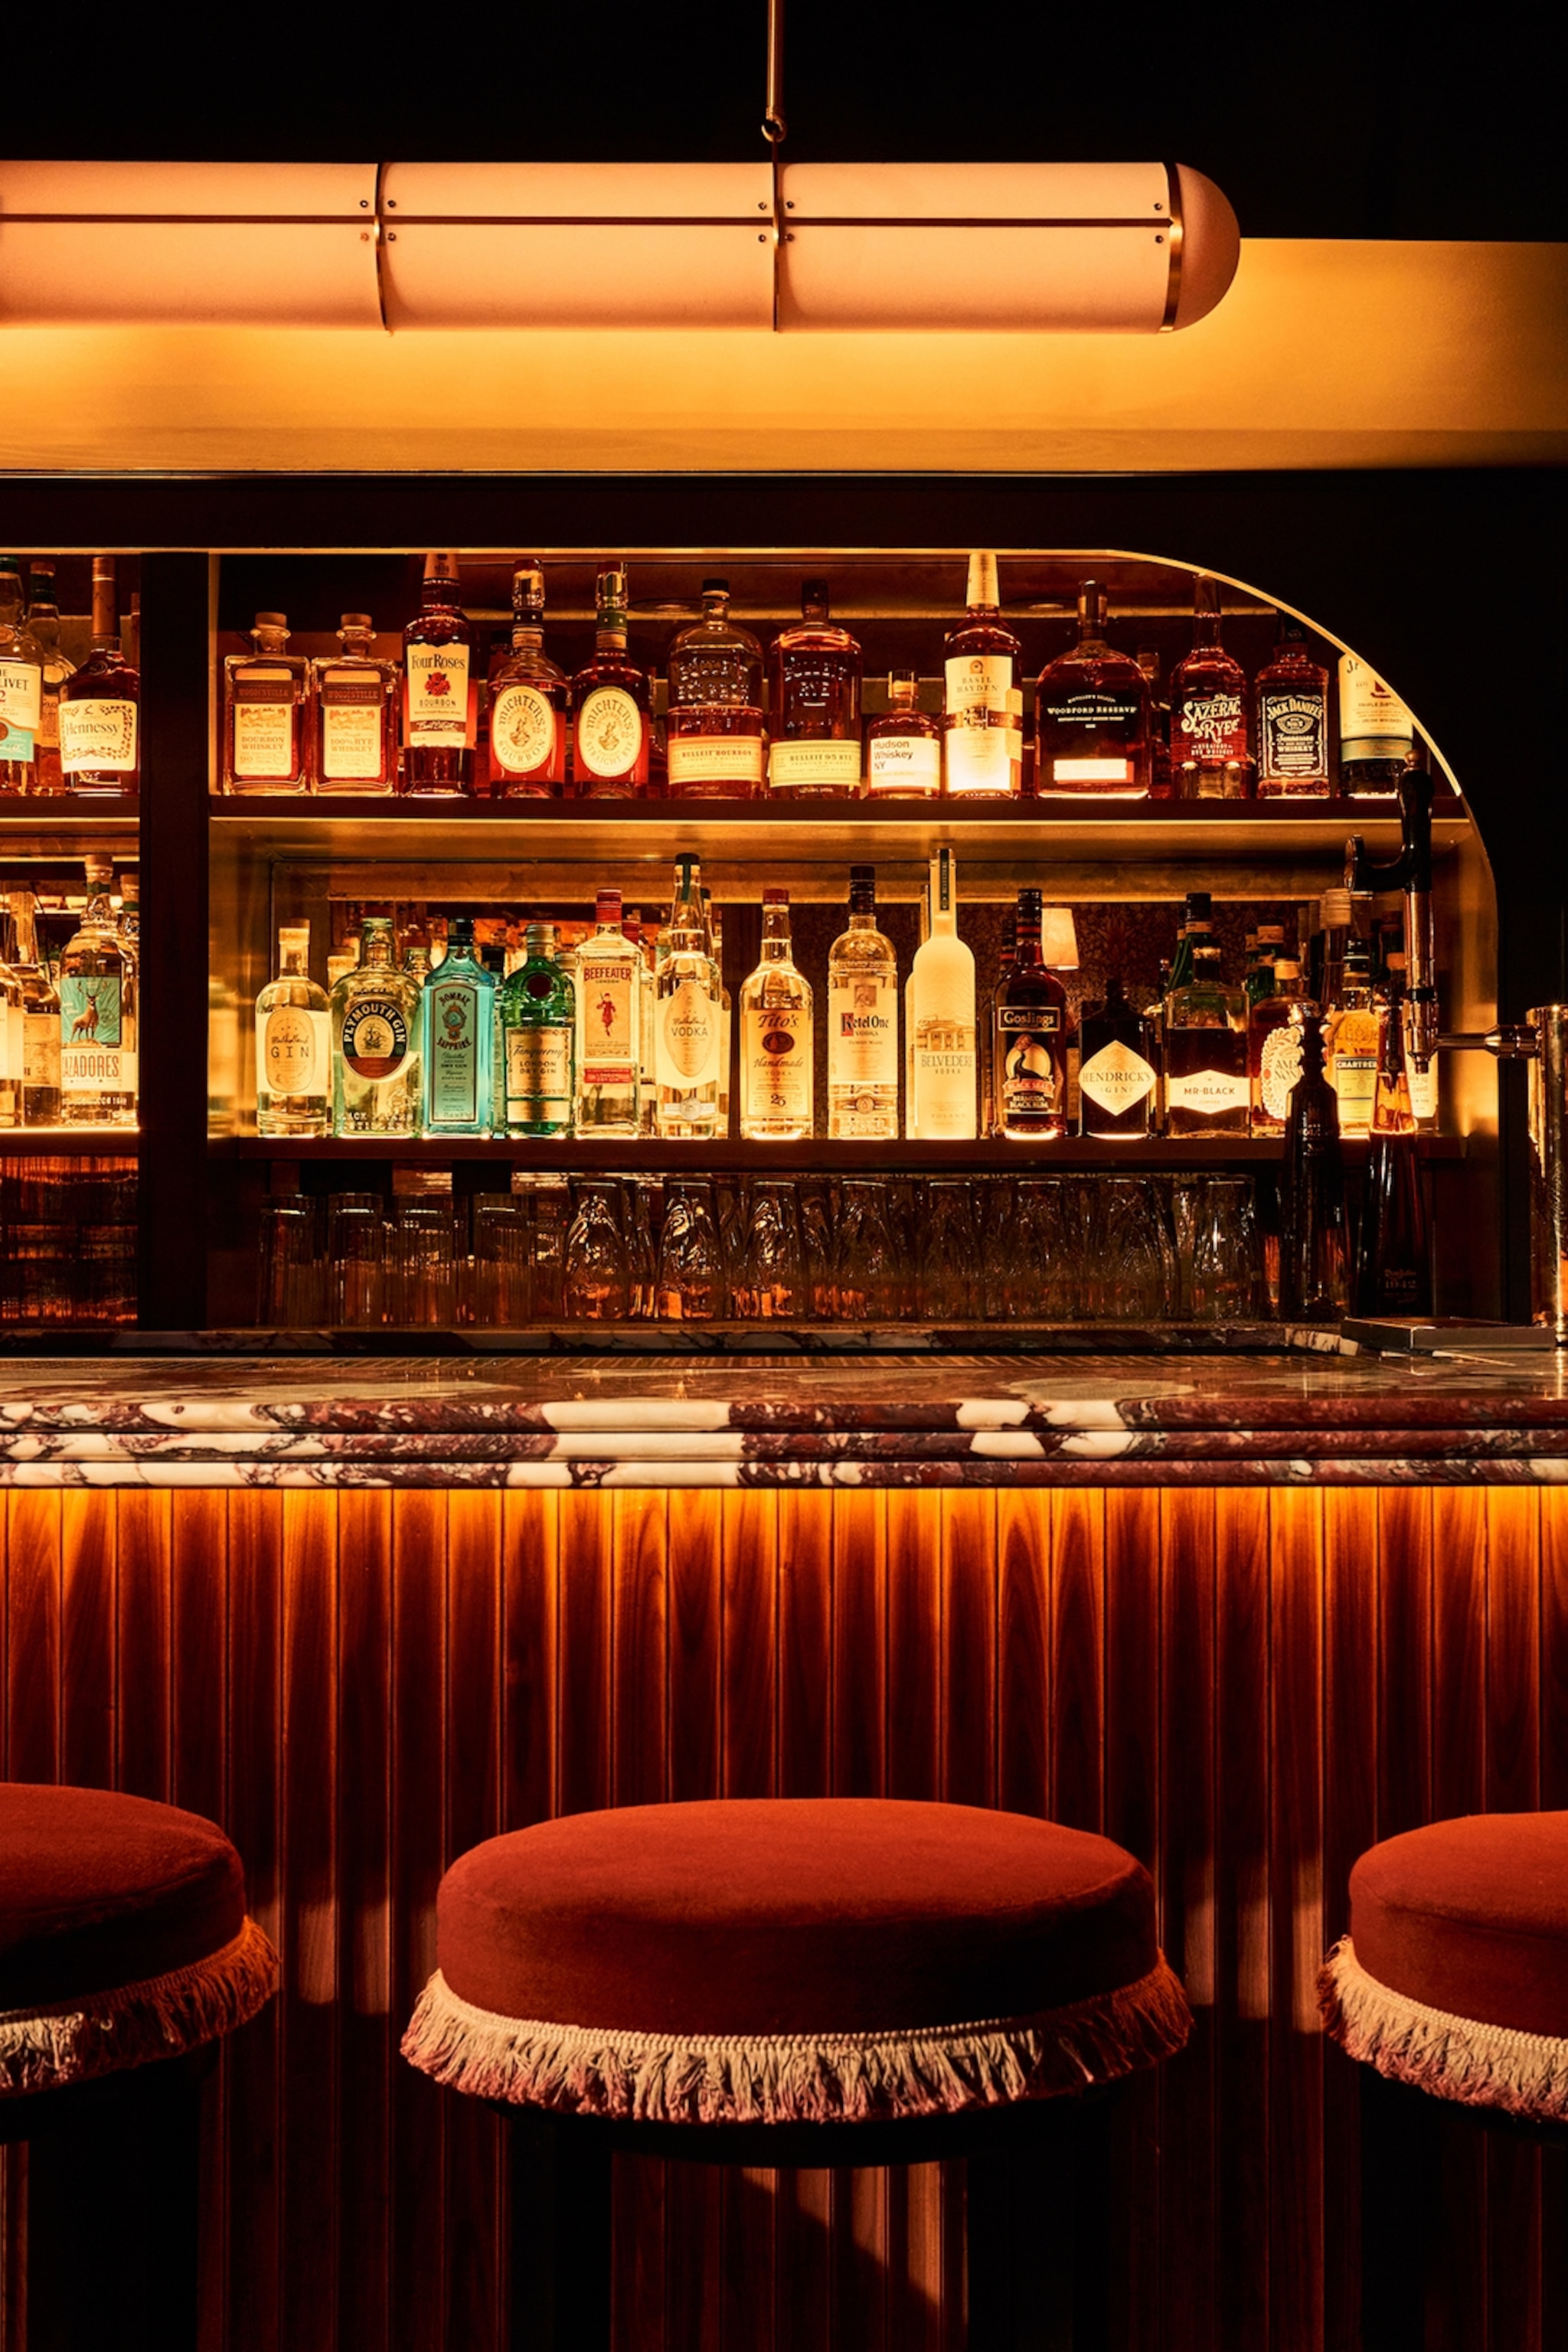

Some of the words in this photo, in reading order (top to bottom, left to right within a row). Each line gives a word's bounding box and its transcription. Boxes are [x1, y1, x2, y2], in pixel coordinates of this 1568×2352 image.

[957, 684, 998, 693] HAYDEN
[420, 698, 457, 707] BOURBON
[1267, 702, 1289, 720] JACK
[1289, 698, 1324, 720] DANIEL'S
[1047, 706, 1094, 715] WOODFORD
[1181, 700, 1241, 733] SAZERAC
[67, 722, 120, 737] Hennessy
[499, 739, 546, 763] BOURBON
[874, 740, 909, 750] Hudson
[874, 750, 913, 760] Whiskey
[874, 762, 886, 770] NY
[584, 967, 632, 981] BEEFEATER
[439, 992, 471, 1007] BOMBAY
[344, 1004, 394, 1043] PLYMOUTH
[393, 1020, 406, 1043] GIN
[758, 1014, 799, 1028] Tito's
[842, 1016, 870, 1032] Ketel
[871, 1015, 889, 1028] One
[1004, 1011, 1054, 1028] Goslings
[671, 1027, 708, 1037] VODKA
[271, 1046, 309, 1058] GIN
[513, 1045, 564, 1058] Tanqueray
[753, 1056, 804, 1068] Handmade
[920, 1054, 972, 1067] BELVEDERE
[1083, 1072, 1152, 1083] HENDRICK'S
